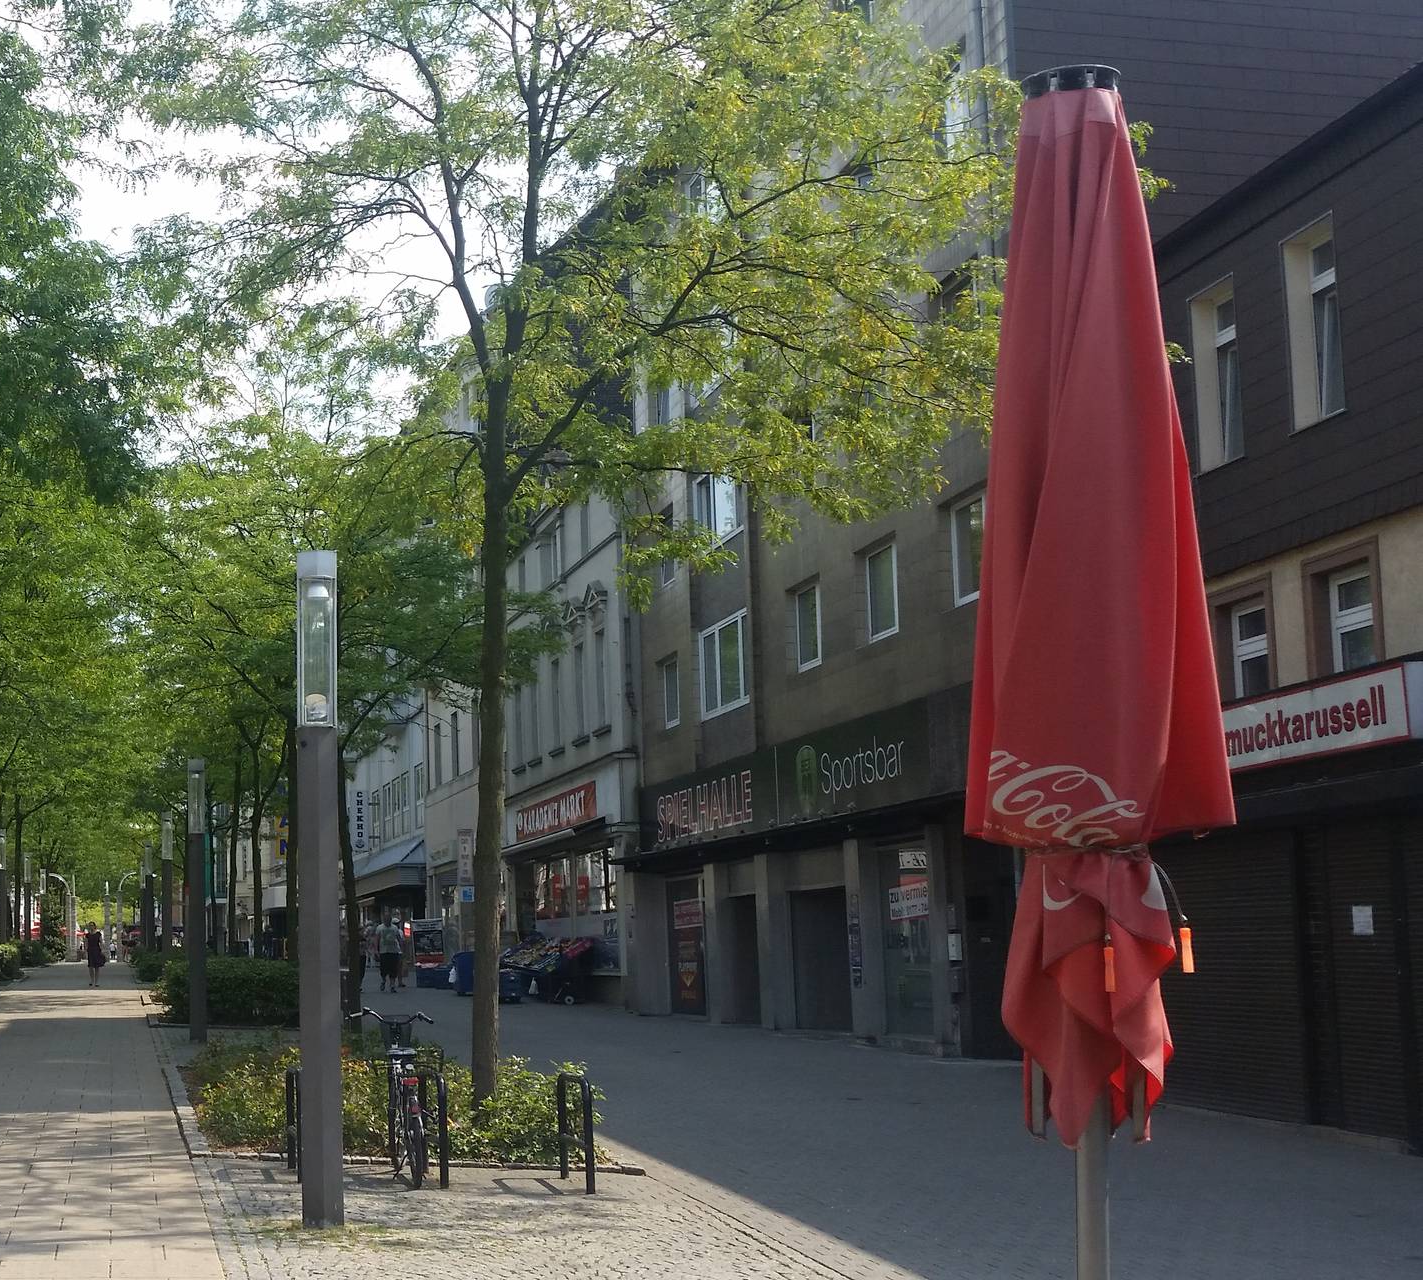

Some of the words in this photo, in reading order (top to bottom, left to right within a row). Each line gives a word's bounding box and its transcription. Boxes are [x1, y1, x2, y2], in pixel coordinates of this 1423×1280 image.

[820, 736, 904, 804] Sportsbar
[560, 790, 585, 824] MARKT
[657, 769, 753, 843] SPIELHALLE
